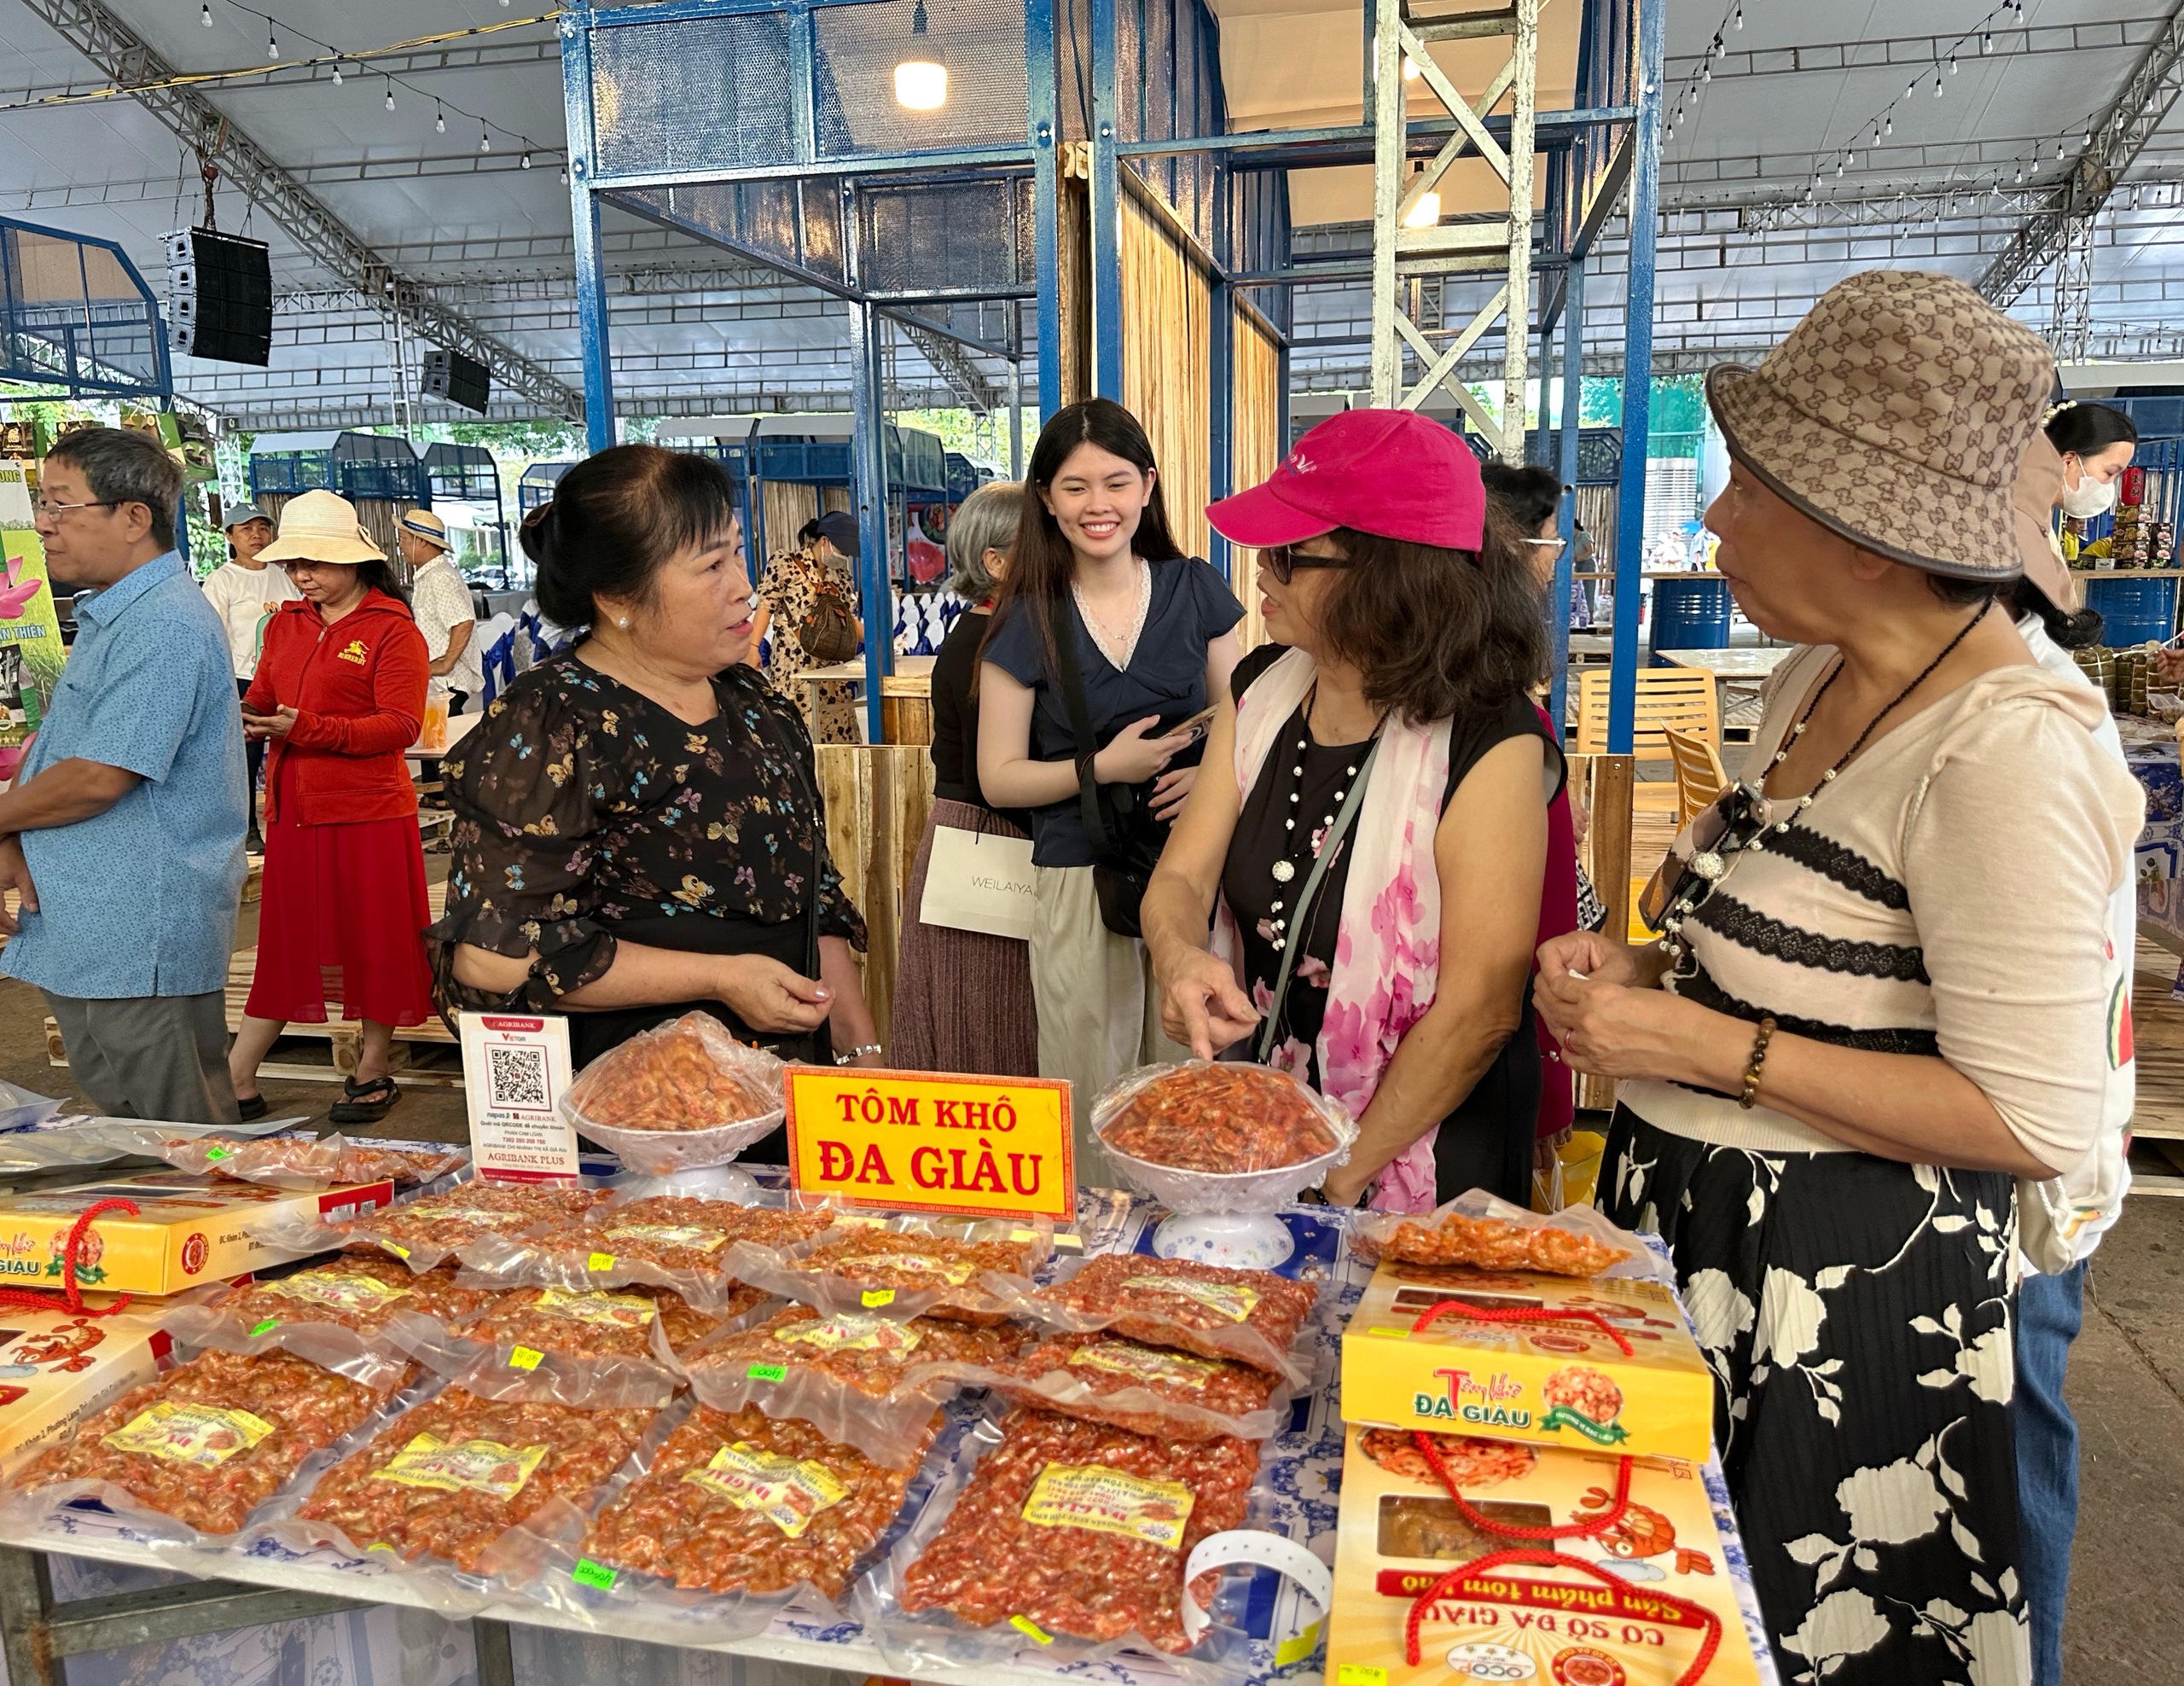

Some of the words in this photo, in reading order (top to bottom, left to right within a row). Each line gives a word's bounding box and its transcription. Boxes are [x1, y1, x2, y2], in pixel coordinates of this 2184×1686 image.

[13, 623, 47, 640] THIÊN
[972, 875, 1033, 895] WEILAIYA
[836, 1087, 921, 1126] TÔM
[934, 1095, 1017, 1132] KHÔ
[487, 1152, 538, 1164] AGRIBANK
[540, 1155, 565, 1166] PLUS
[817, 1141, 895, 1185] ĐA
[910, 1137, 1043, 1196] GIÀU
[1413, 1392, 1455, 1419] ĐA
[1462, 1404, 1531, 1428] GIÀU
[1141, 1528, 1170, 1539] OCOP
[1531, 1585, 1615, 1609] phẩm
[1623, 1594, 1682, 1620] Sản
[1422, 1605, 1499, 1626] GIÀU
[1511, 1611, 1557, 1632] ĐA
[1567, 1618, 1611, 1642] SỞ
[1621, 1625, 1665, 1646] CƠ
[1458, 1662, 1524, 1678] OCOP
